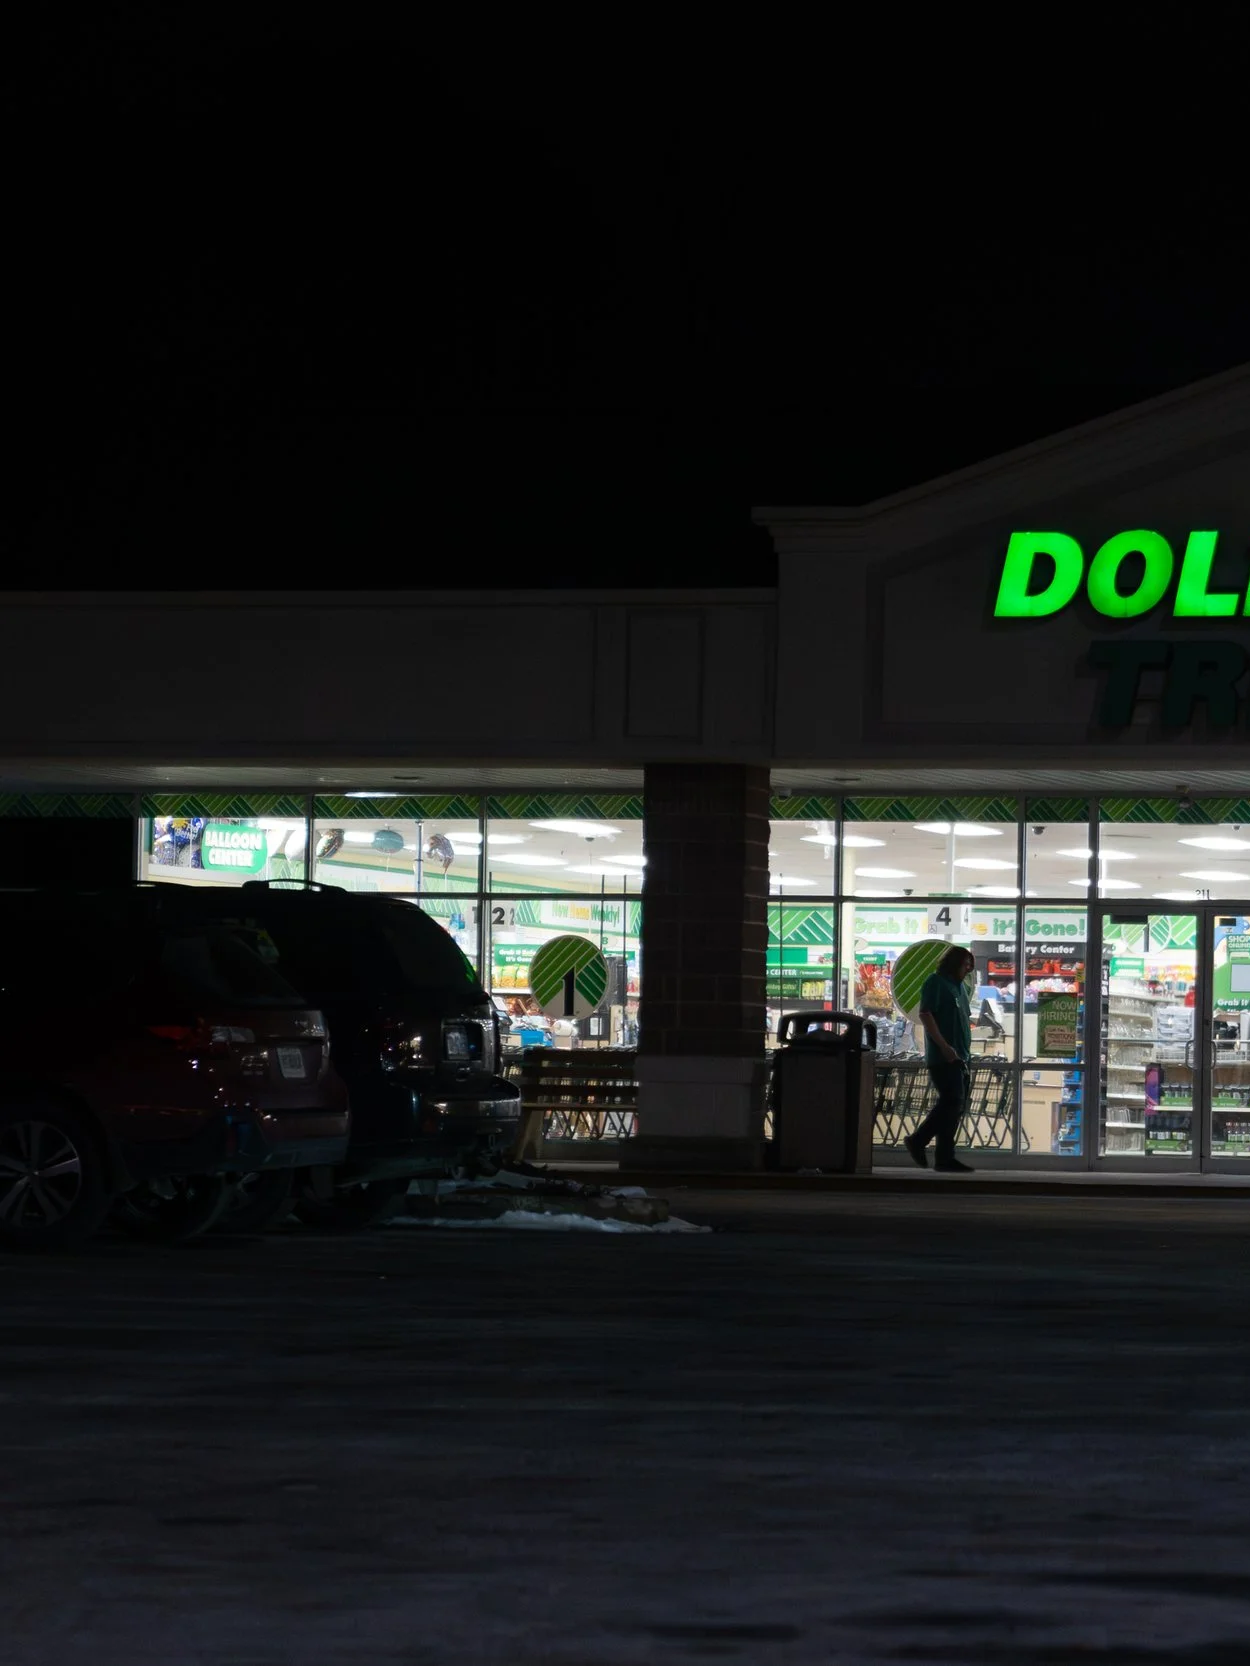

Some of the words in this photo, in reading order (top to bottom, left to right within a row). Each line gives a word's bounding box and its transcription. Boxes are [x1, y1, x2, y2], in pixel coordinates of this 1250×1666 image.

[205, 831, 263, 851] BALLOON
[209, 849, 254, 867] CENTER
[492, 906, 505, 925] 2
[936, 906, 952, 927] 4
[855, 917, 899, 934] Grab
[1025, 919, 1085, 936] Gone!
[1040, 945, 1075, 954] Center
[1052, 1000, 1077, 1010] NOW
[1217, 998, 1239, 1006] Grab
